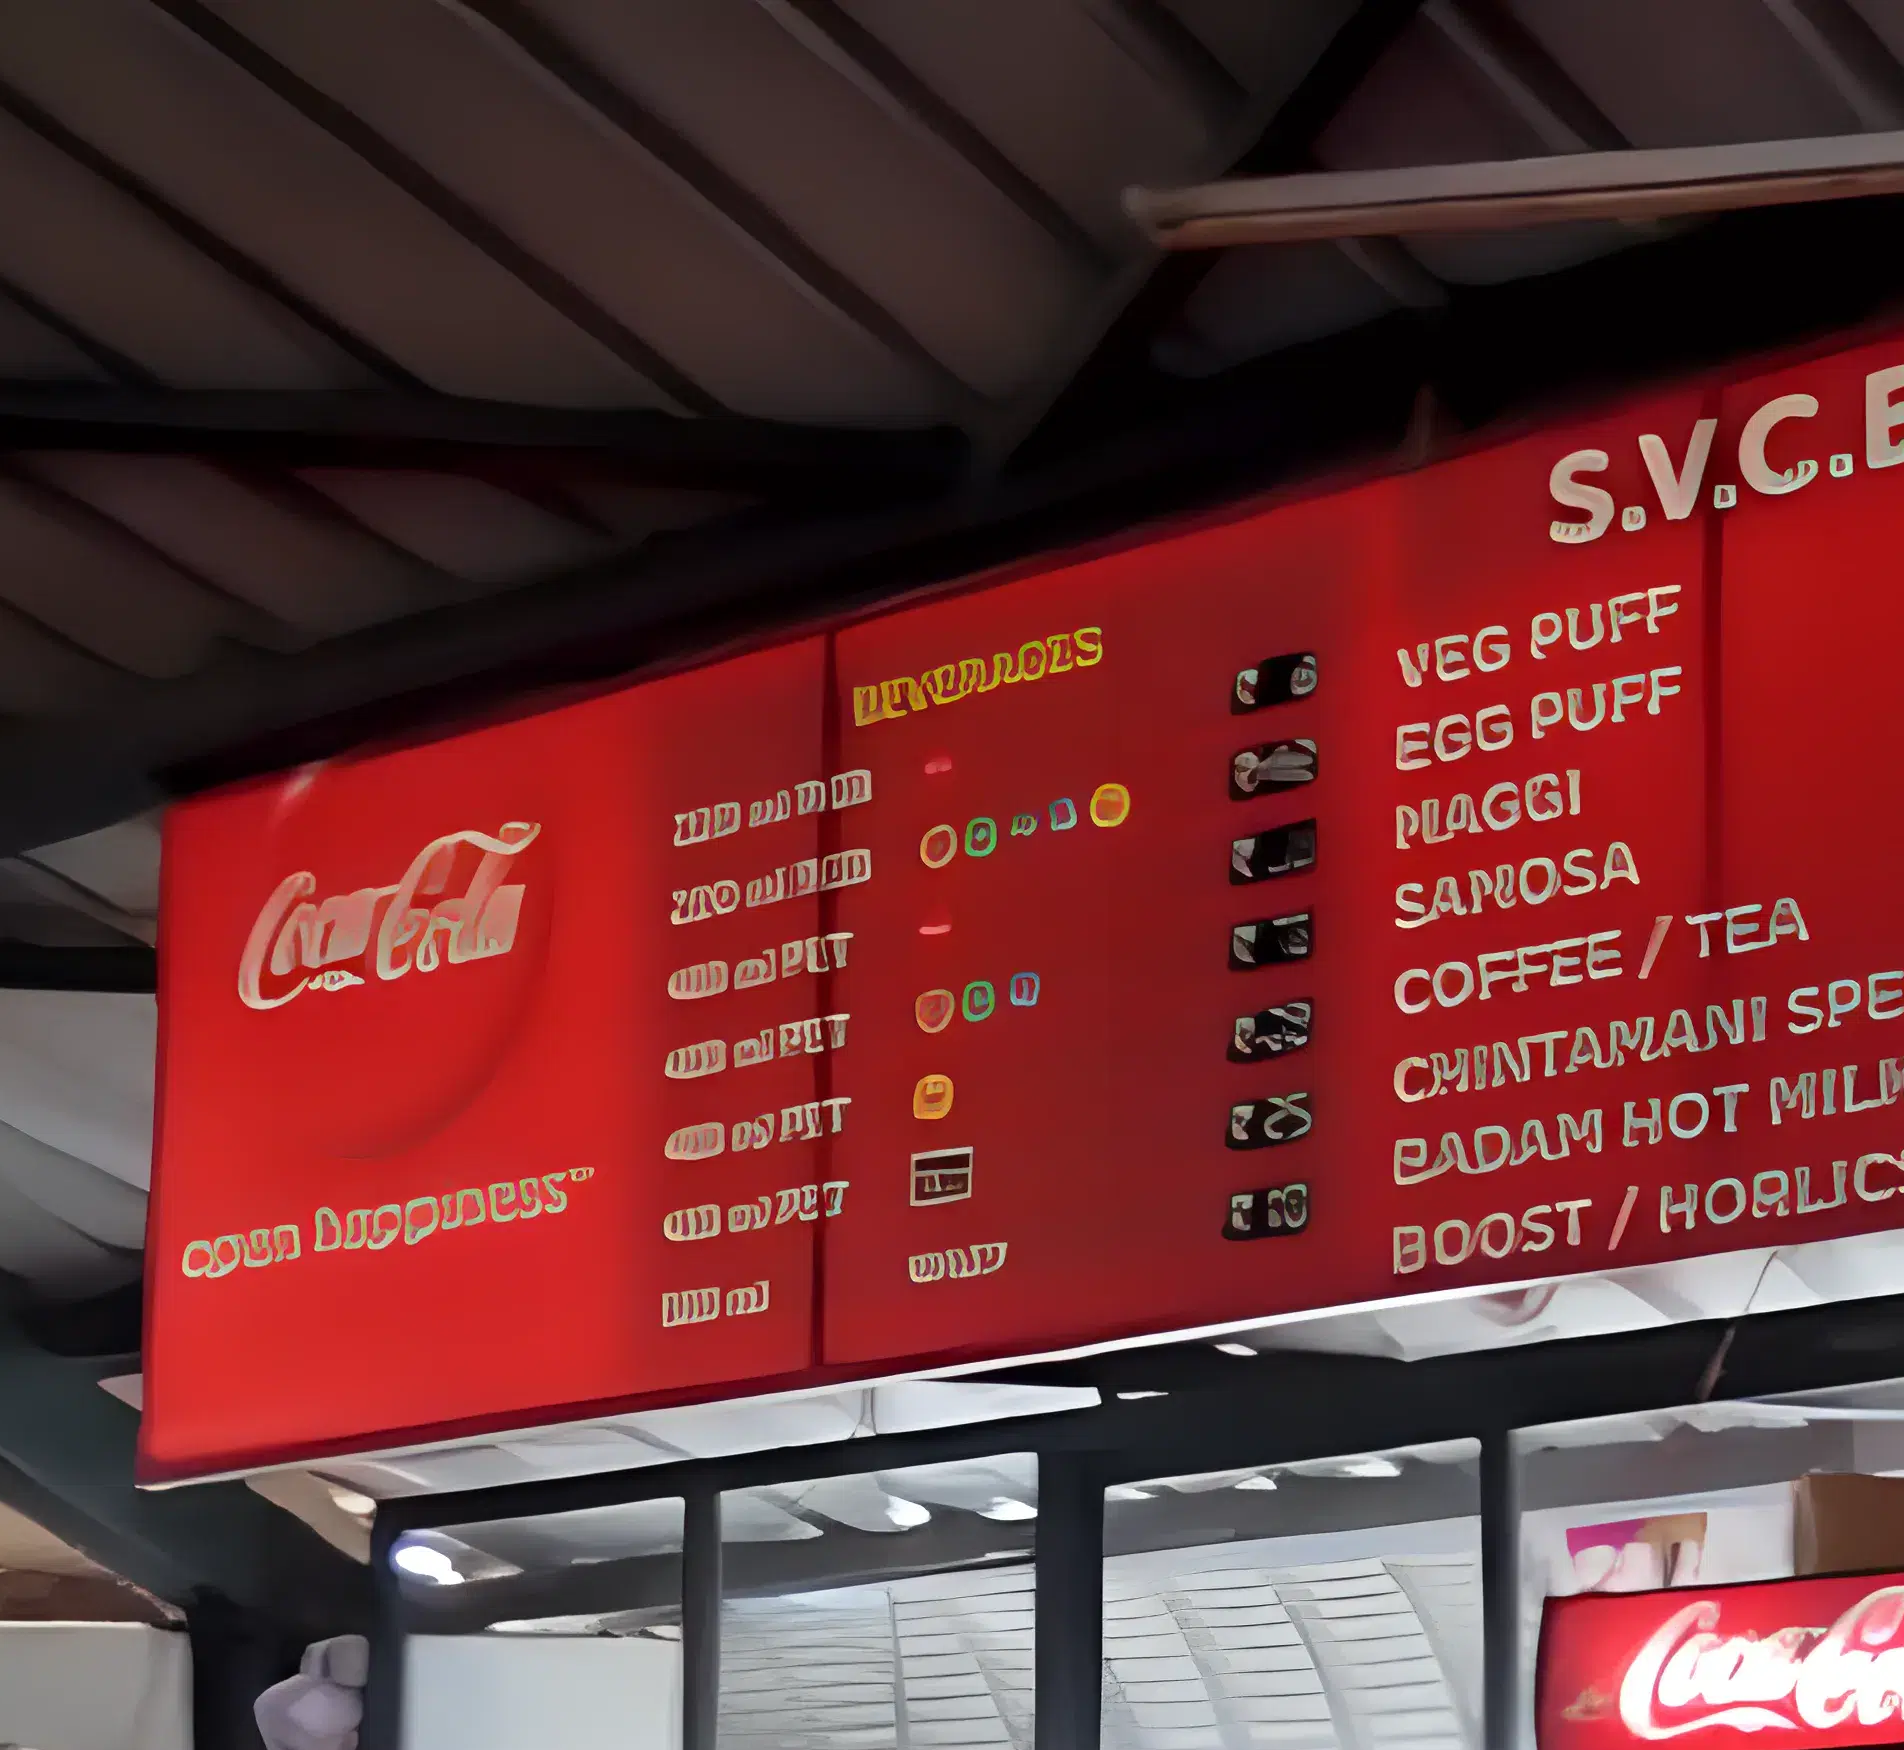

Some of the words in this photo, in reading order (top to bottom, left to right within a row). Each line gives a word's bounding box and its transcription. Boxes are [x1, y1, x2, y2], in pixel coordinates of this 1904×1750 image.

[1397, 625, 1510, 687] VEG
[1531, 585, 1681, 659] PUFF
[1396, 704, 1513, 770] EGG
[1531, 666, 1682, 739] PUFF
[1394, 925, 1623, 1014] COFFEE
[1685, 898, 1809, 958] TEA
[1623, 1083, 1749, 1147] HOT
[1393, 1199, 1596, 1276] BOOST
